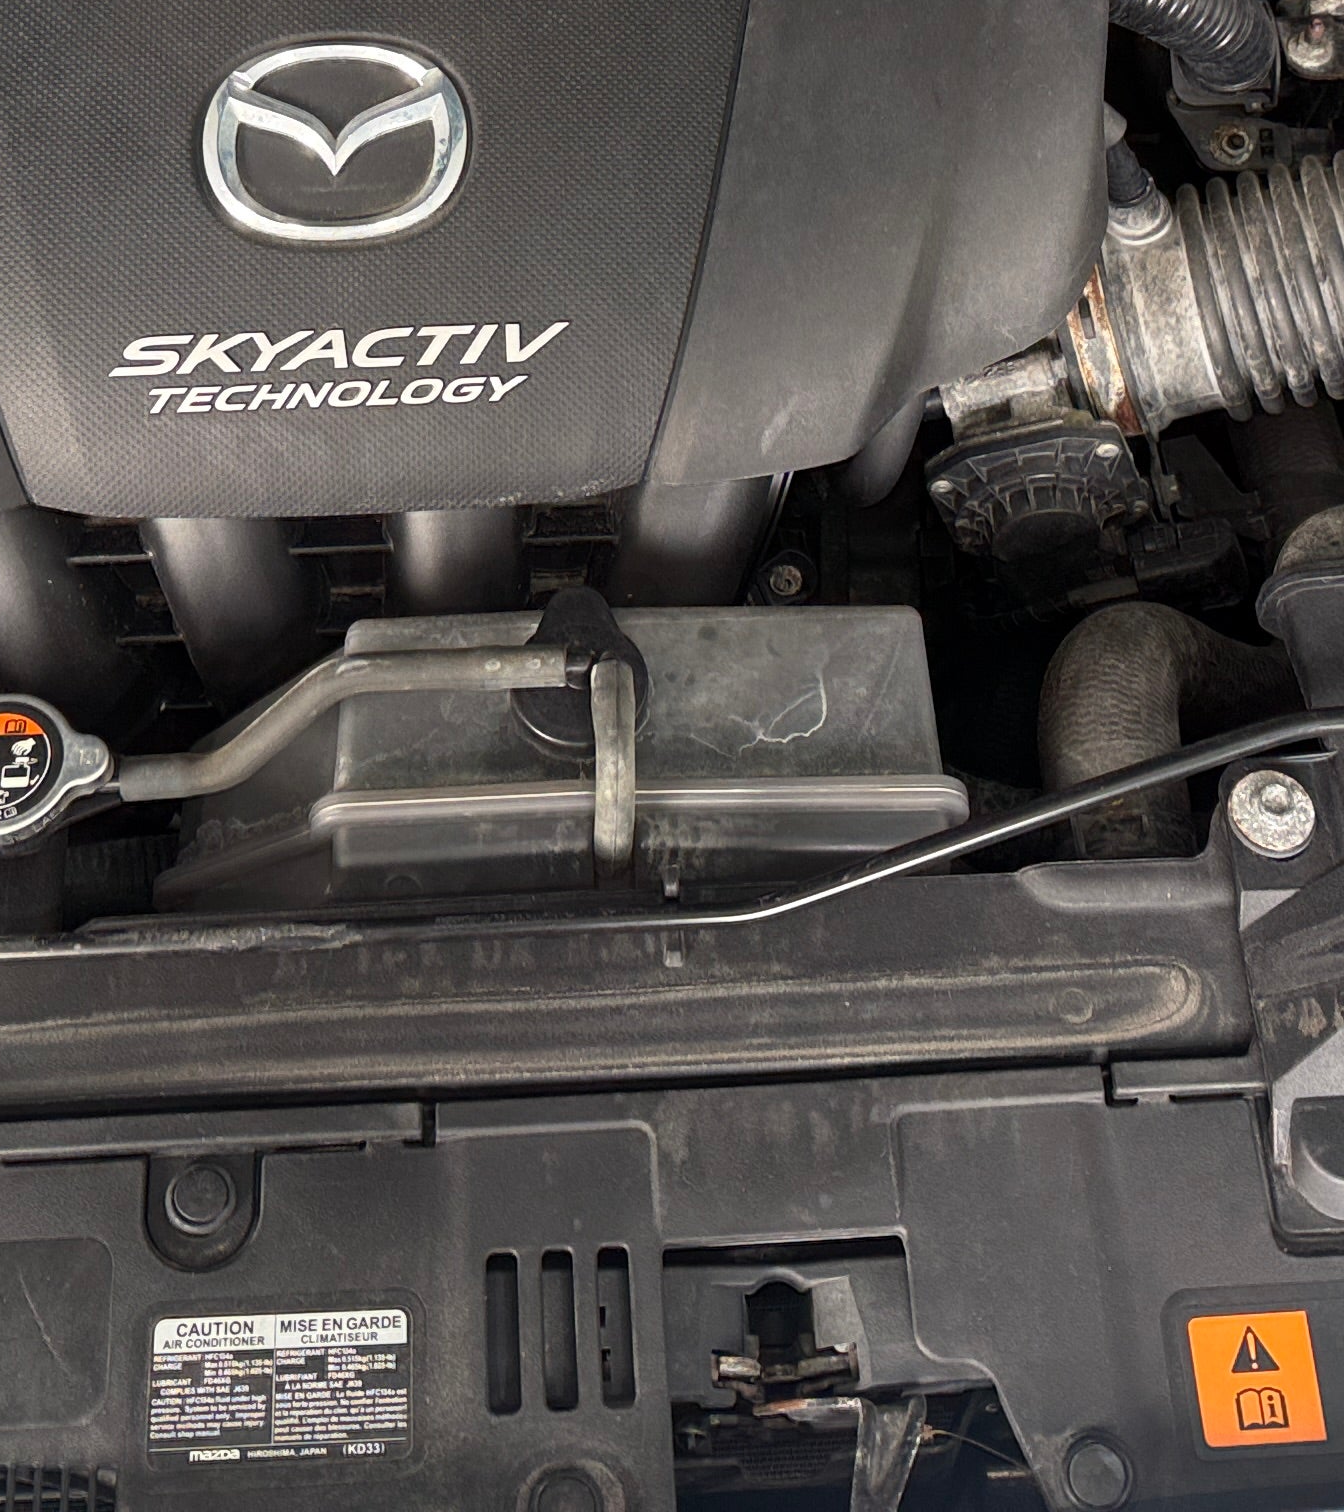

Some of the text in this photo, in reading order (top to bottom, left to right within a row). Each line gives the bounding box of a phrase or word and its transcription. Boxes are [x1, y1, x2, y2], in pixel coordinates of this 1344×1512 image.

[108, 321, 569, 376] SKYACTIV
[148, 375, 529, 414] TECHNOLOGY
[176, 1320, 255, 1337] CAUTION
[280, 1315, 402, 1332] MISE EN GARDE
[163, 1336, 265, 1350] AIR CONDITIONER
[300, 1332, 378, 1345] CLIMATISEUR
[153, 1362, 182, 1371] CHARGE
[276, 1357, 306, 1366] CHARGE
[152, 1378, 192, 1388] LUBRICANT
[275, 1372, 318, 1381] LUBRIFIANT
[160, 1387, 196, 1396] COMPLIES
[196, 1386, 215, 1394] WITH
[215, 1385, 231, 1393] SAE
[291, 1382, 302, 1390] LA
[302, 1381, 328, 1389] NORME
[329, 1380, 344, 1388] SAE
[247, 1448, 298, 1458] HIROSHIMA,
[299, 1446, 328, 1456] JAPAN
[342, 1442, 385, 1456] (KD33)
